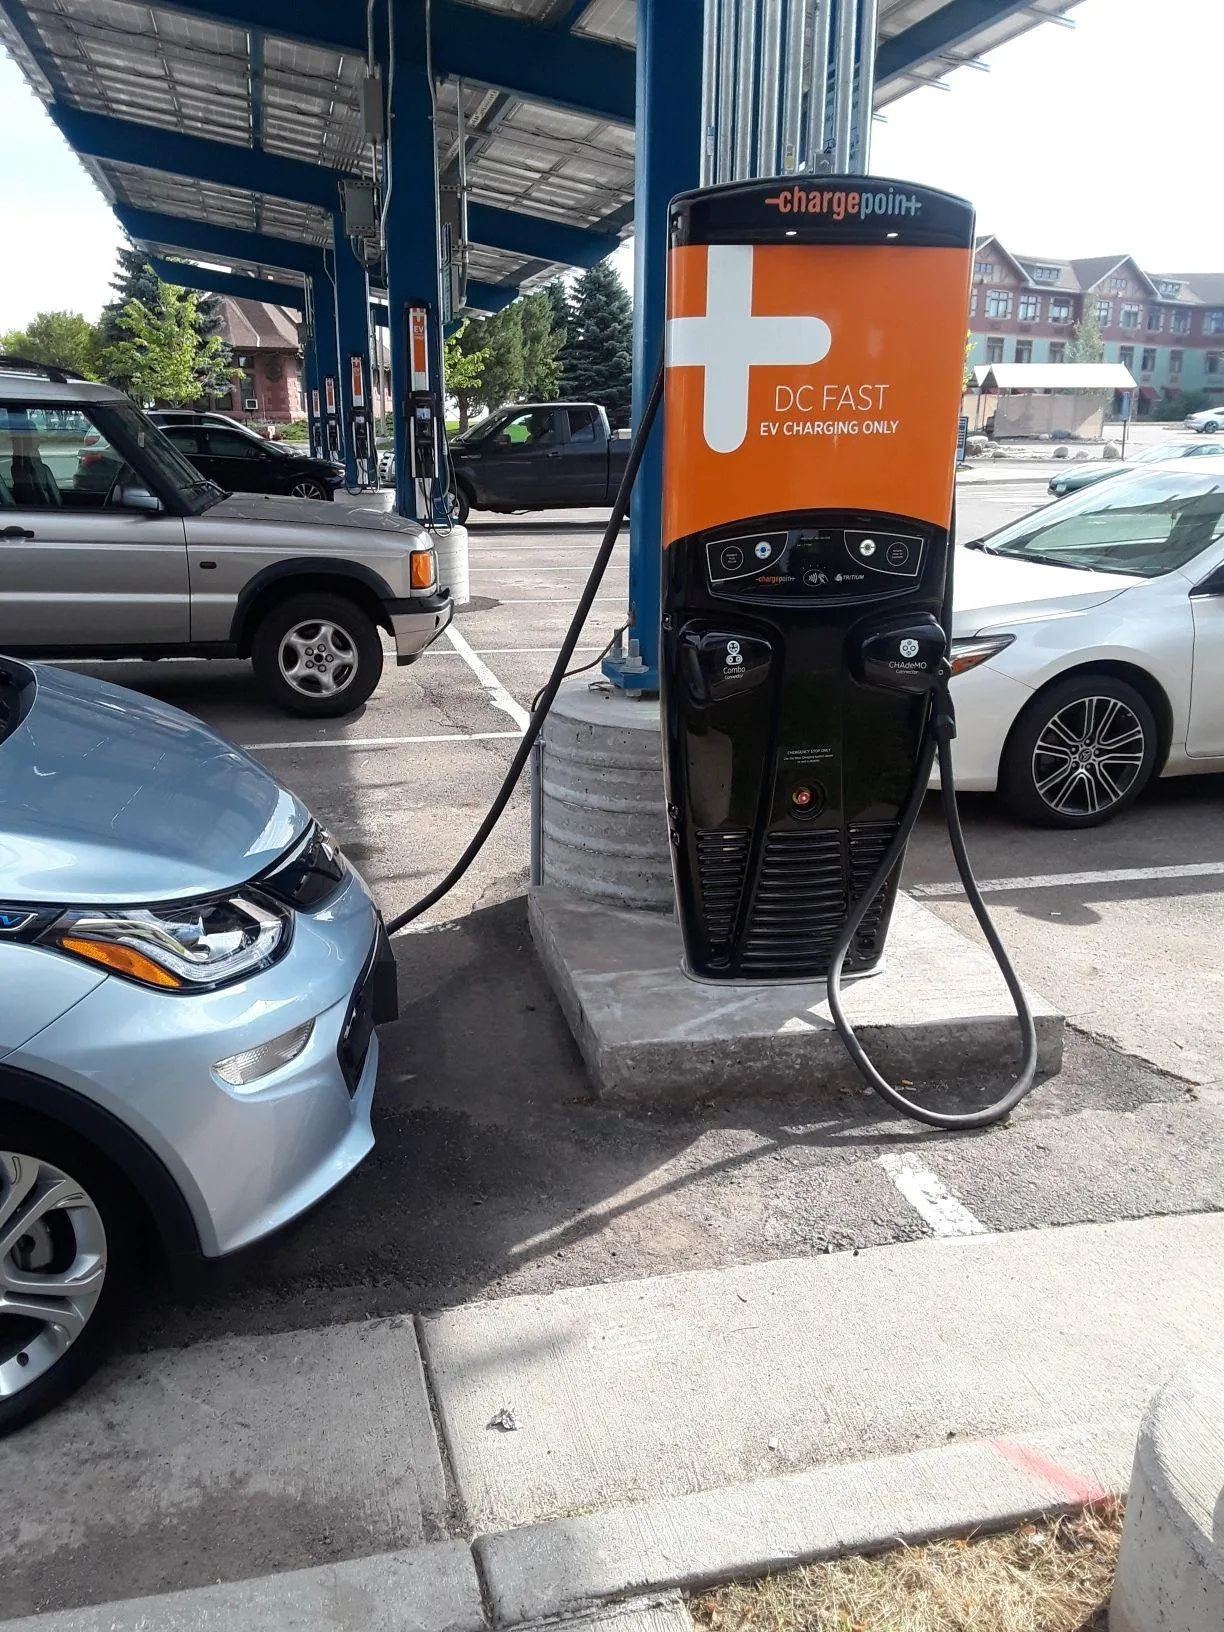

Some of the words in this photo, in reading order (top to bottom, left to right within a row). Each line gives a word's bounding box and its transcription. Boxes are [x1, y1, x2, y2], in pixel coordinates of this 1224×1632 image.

[775, 385, 813, 411] DC
[822, 384, 890, 411] FAST
[760, 422, 779, 435] EV
[783, 420, 859, 435] CHARGING
[863, 420, 899, 434] ONLY
[723, 666, 746, 674] Combo
[889, 661, 927, 669] CHAdeMO
